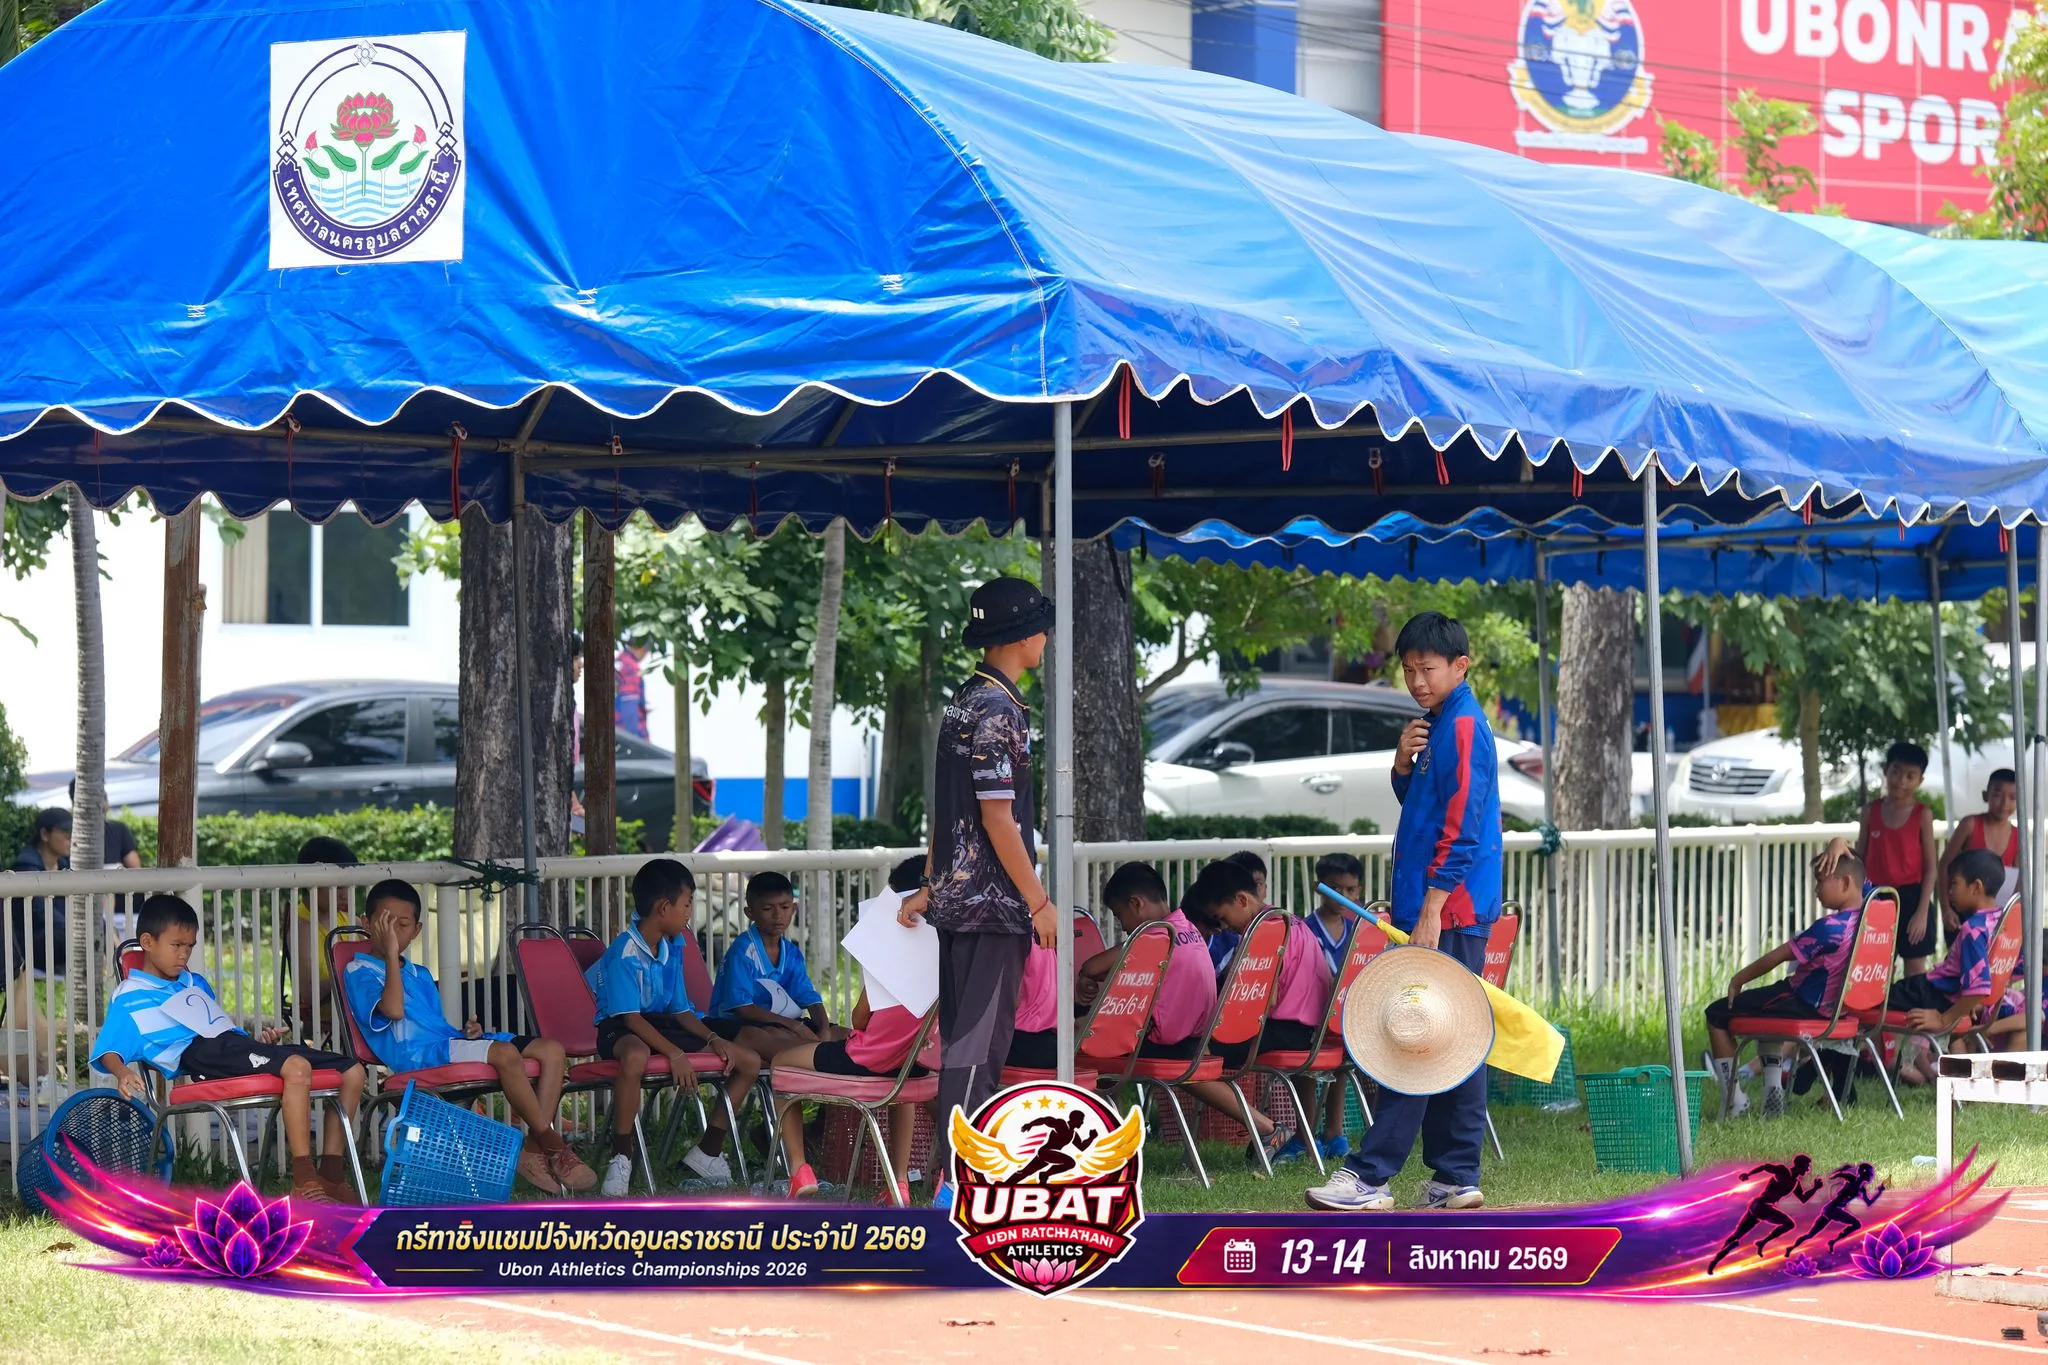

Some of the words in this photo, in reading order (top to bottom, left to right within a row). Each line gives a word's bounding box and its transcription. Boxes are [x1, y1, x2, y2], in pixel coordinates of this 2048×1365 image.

[1740, 0, 2048, 72] UBONRA
[1823, 88, 2001, 167] SPOR
[283, 171, 449, 255] เทศบาลนครอุบลราชธานี
[186, 994, 225, 1025] 2
[1098, 993, 1148, 1015] 256/64
[1230, 980, 1267, 1001] 179/64
